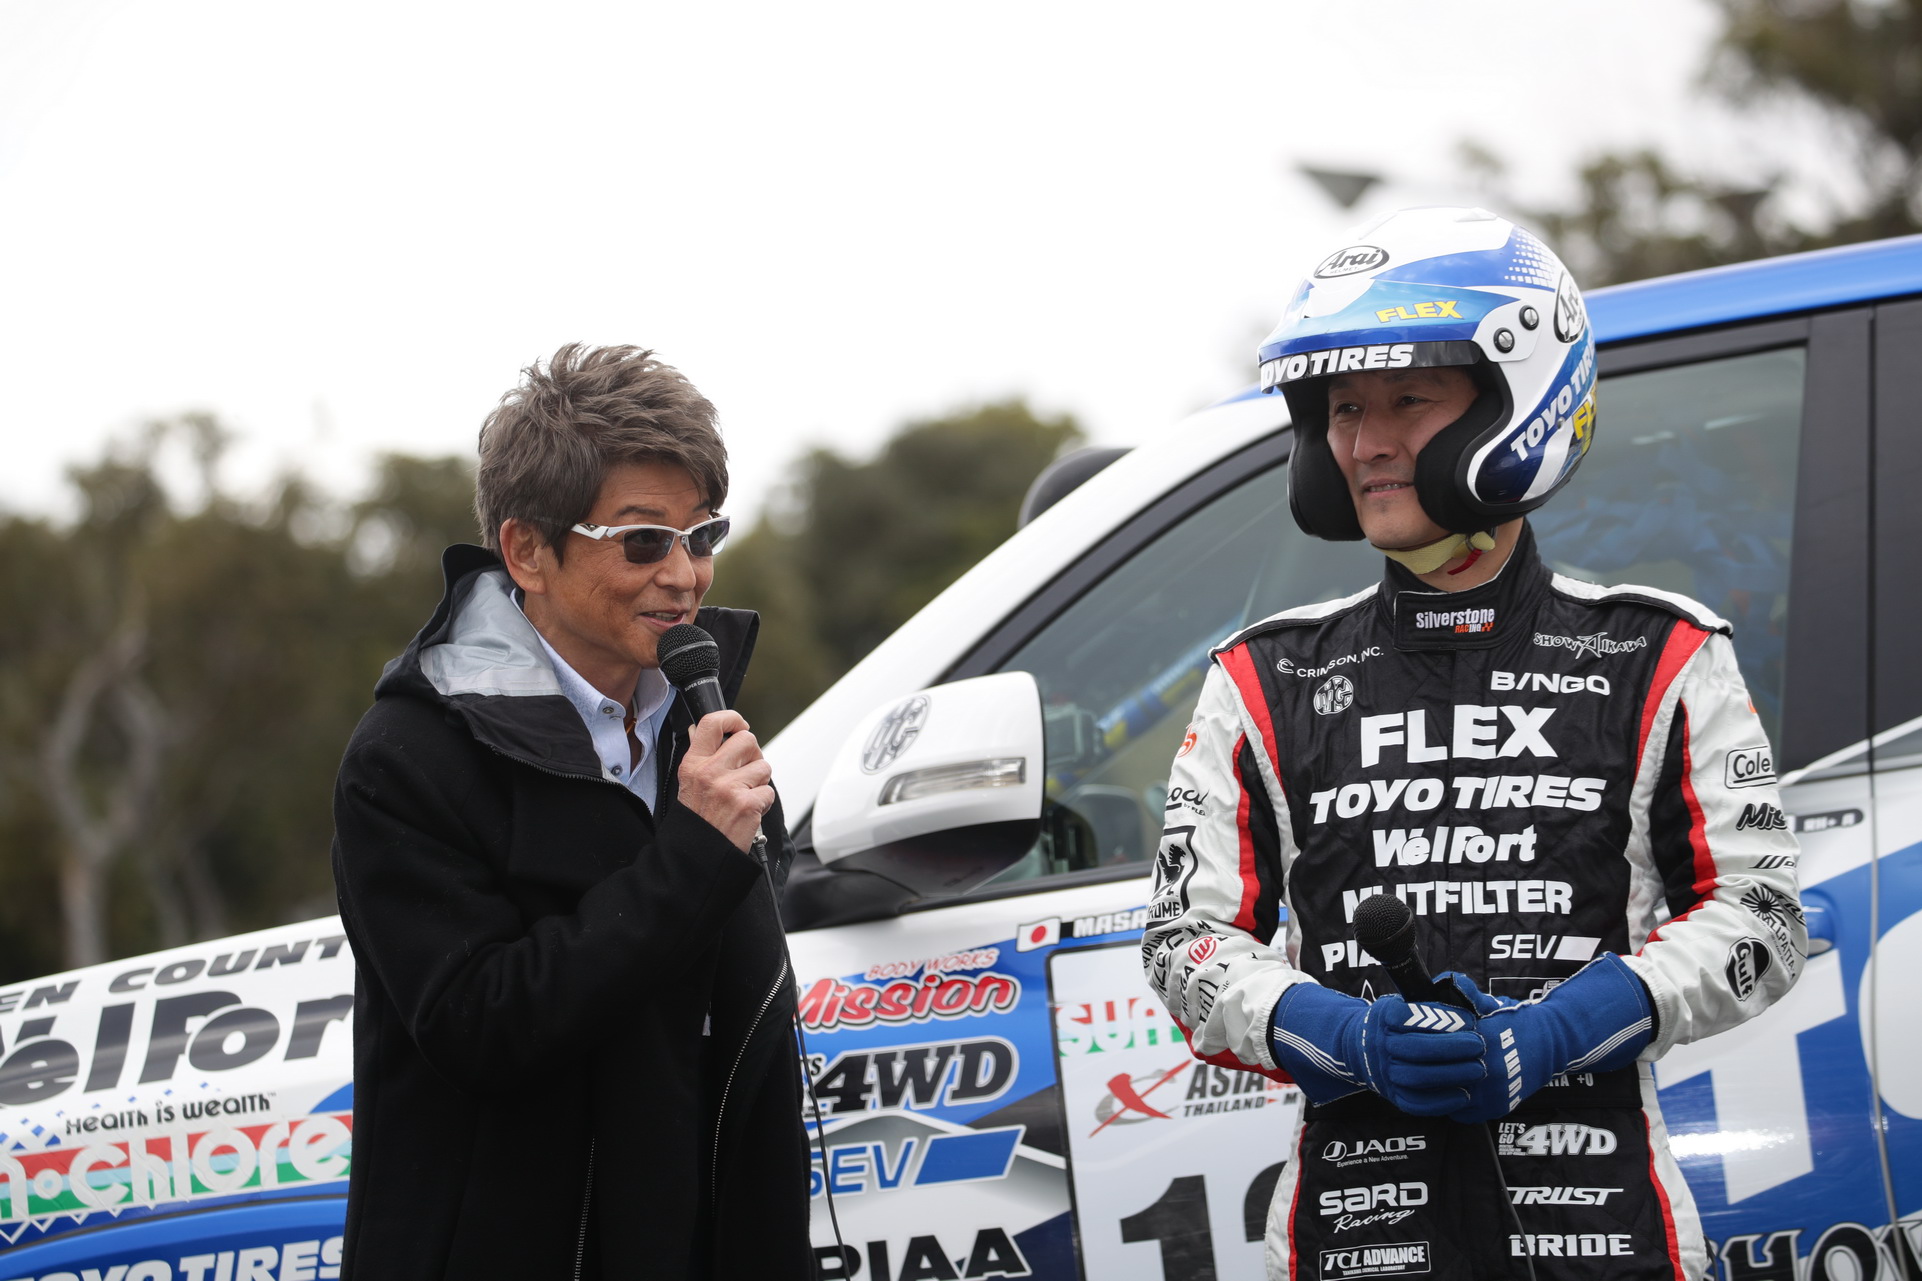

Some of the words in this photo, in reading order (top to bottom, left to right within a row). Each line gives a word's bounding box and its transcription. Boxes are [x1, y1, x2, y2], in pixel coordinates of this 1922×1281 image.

[1317, 249, 1381, 274] Arai
[1375, 300, 1465, 323] FLEX
[1260, 355, 1308, 390] OYO
[1311, 344, 1414, 375] TIRES
[1510, 384, 1573, 462] TOYO
[1416, 608, 1495, 629] Silverstone
[1533, 632, 1580, 651] SHOW
[1361, 704, 1558, 769] FLEX
[1733, 751, 1771, 778] Cole
[1309, 777, 1445, 825] TOYO
[1452, 775, 1607, 811] TIRES
[1736, 802, 1788, 831] Mis
[1073, 912, 1148, 938] MASA
[1489, 933, 1557, 962] SEV
[0, 980, 82, 1013] EN
[108, 935, 348, 994] COUNT
[869, 960, 920, 979] BODY
[926, 951, 998, 970] WORKS
[155, 1100, 175, 1124] is
[1184, 1096, 1265, 1117] THAILAND
[1499, 1122, 1526, 1134] LET'S
[1499, 1133, 1515, 1144] GO
[1516, 1123, 1617, 1156] 4WD
[1346, 1135, 1427, 1157] JAOS
[1507, 1186, 1624, 1205] TRUST
[1333, 1206, 1415, 1233] Racing
[1324, 1251, 1362, 1271] TCL
[1363, 1246, 1426, 1266] ADVANCE
[1509, 1234, 1635, 1257] BRIDE
